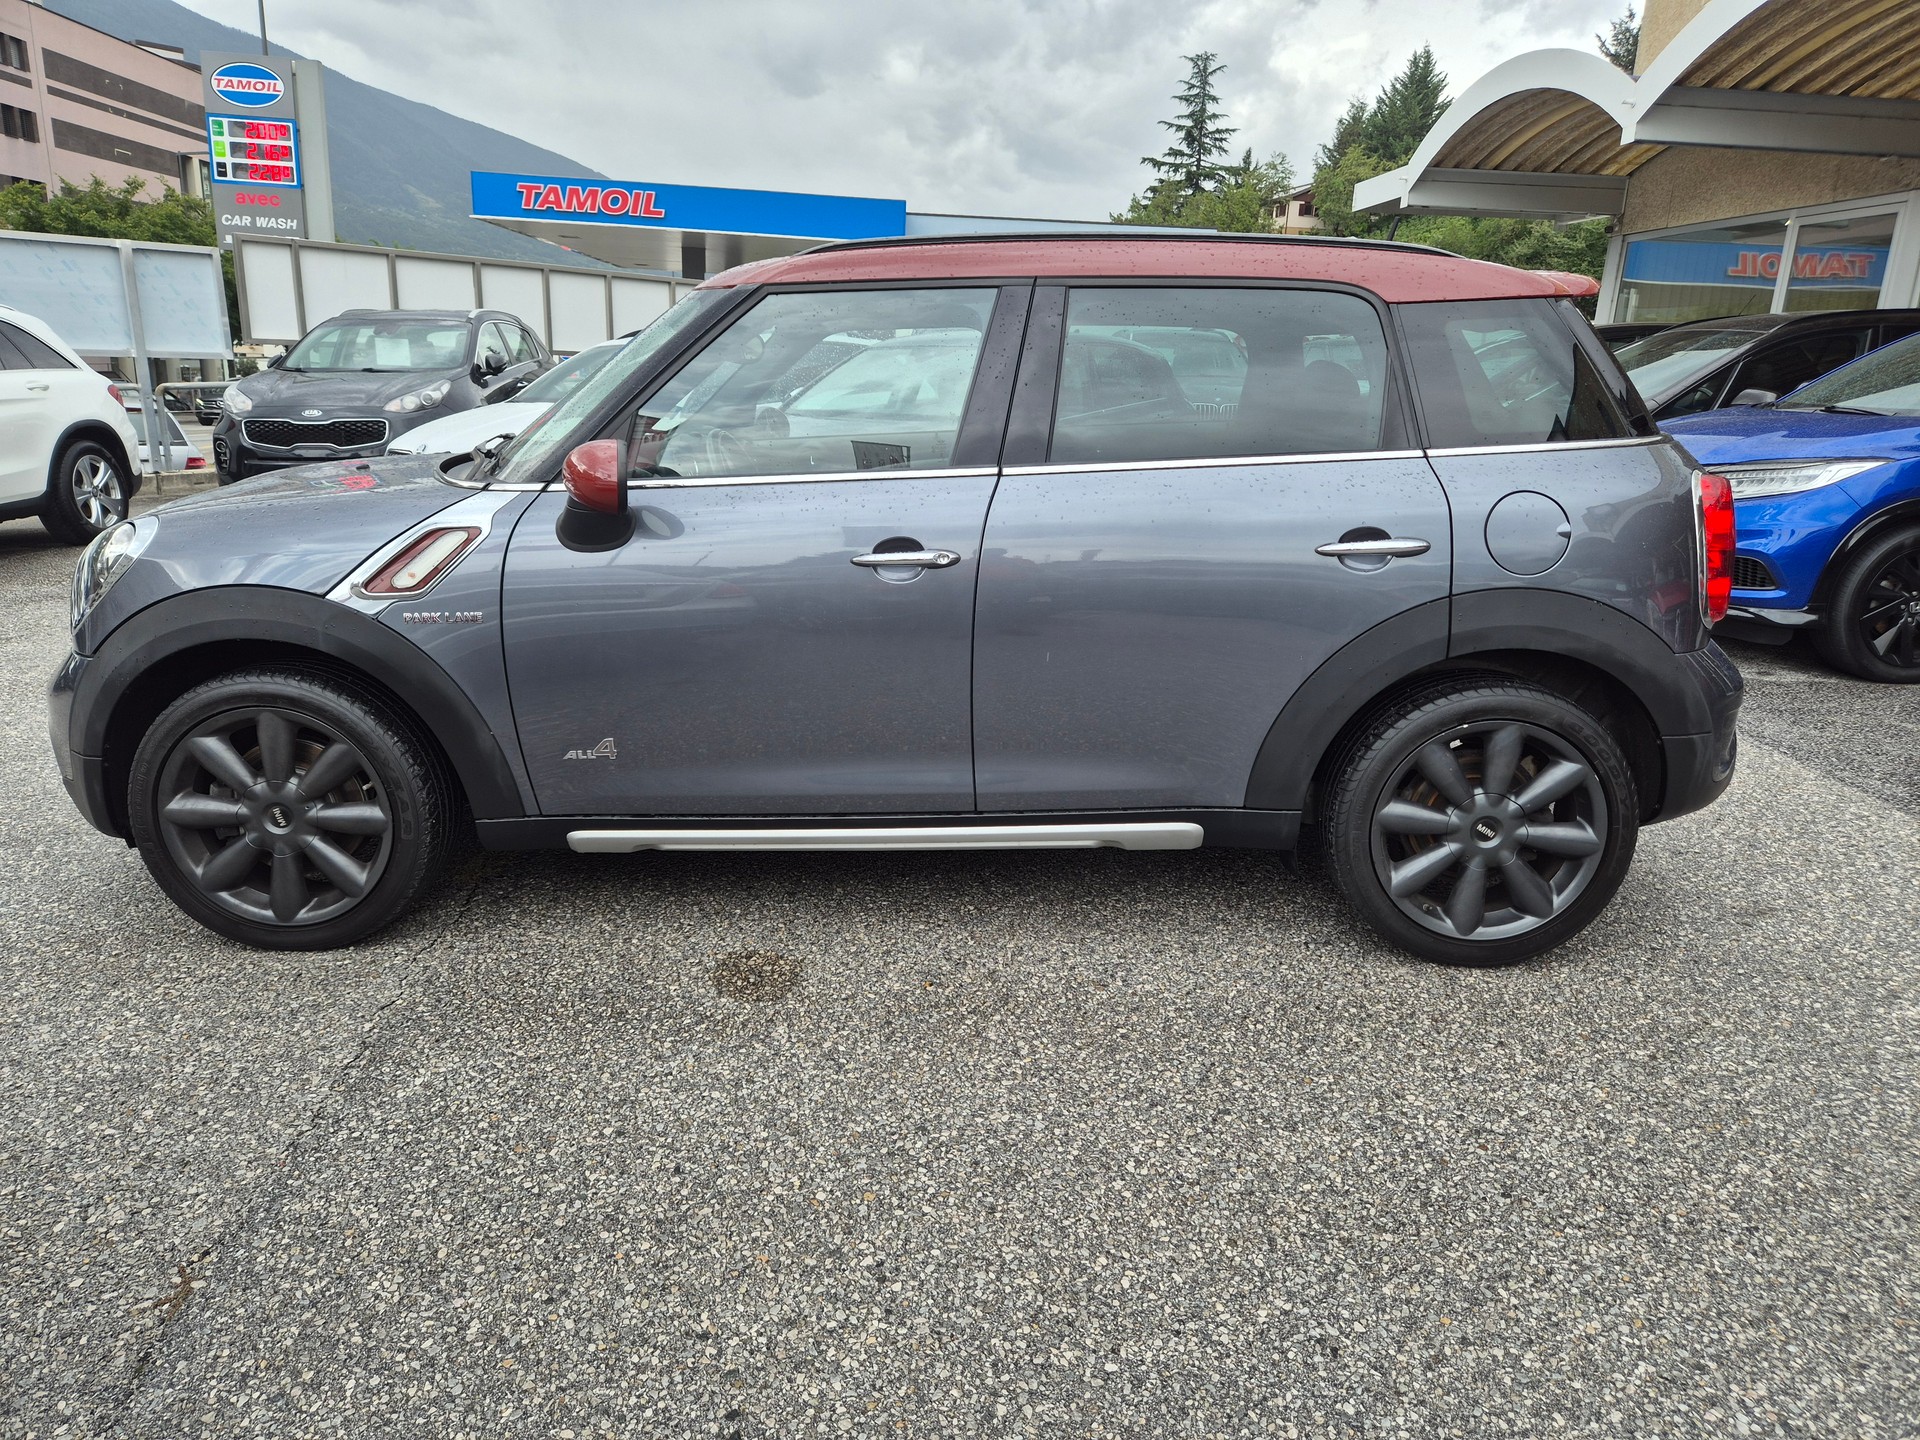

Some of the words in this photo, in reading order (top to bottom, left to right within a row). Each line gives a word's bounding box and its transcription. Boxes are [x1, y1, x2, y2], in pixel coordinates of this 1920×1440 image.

[214, 77, 282, 93] TAMOIL
[235, 192, 281, 207] avec
[517, 183, 666, 218] TAMOIL
[221, 214, 251, 227] CAR
[255, 216, 298, 230] WASH
[403, 611, 442, 625] PARK
[444, 611, 484, 625] LANE
[272, 807, 288, 827] MINI
[1476, 823, 1496, 838] MINI
